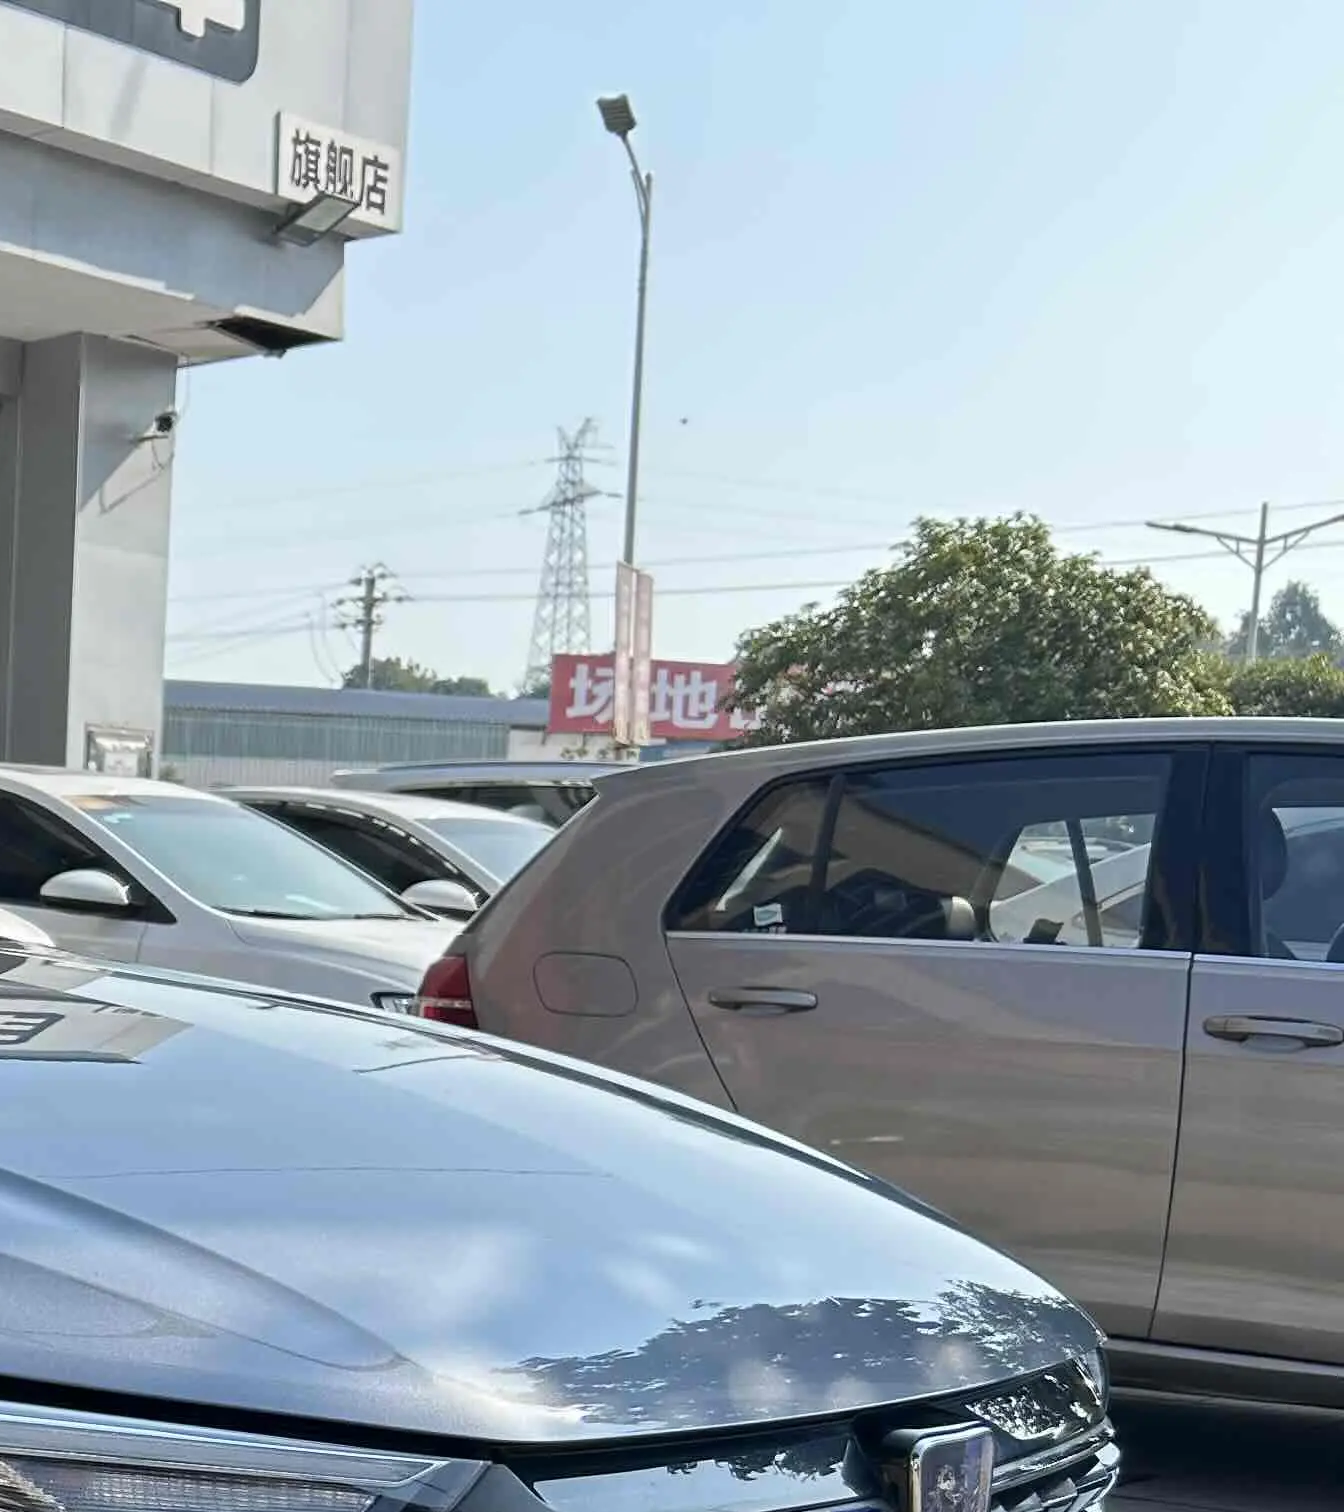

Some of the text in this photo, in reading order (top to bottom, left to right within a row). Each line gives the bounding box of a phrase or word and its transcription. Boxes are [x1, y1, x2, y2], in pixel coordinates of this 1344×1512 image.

[288, 127, 390, 217] 旗舰店
[565, 663, 762, 730] 场地
